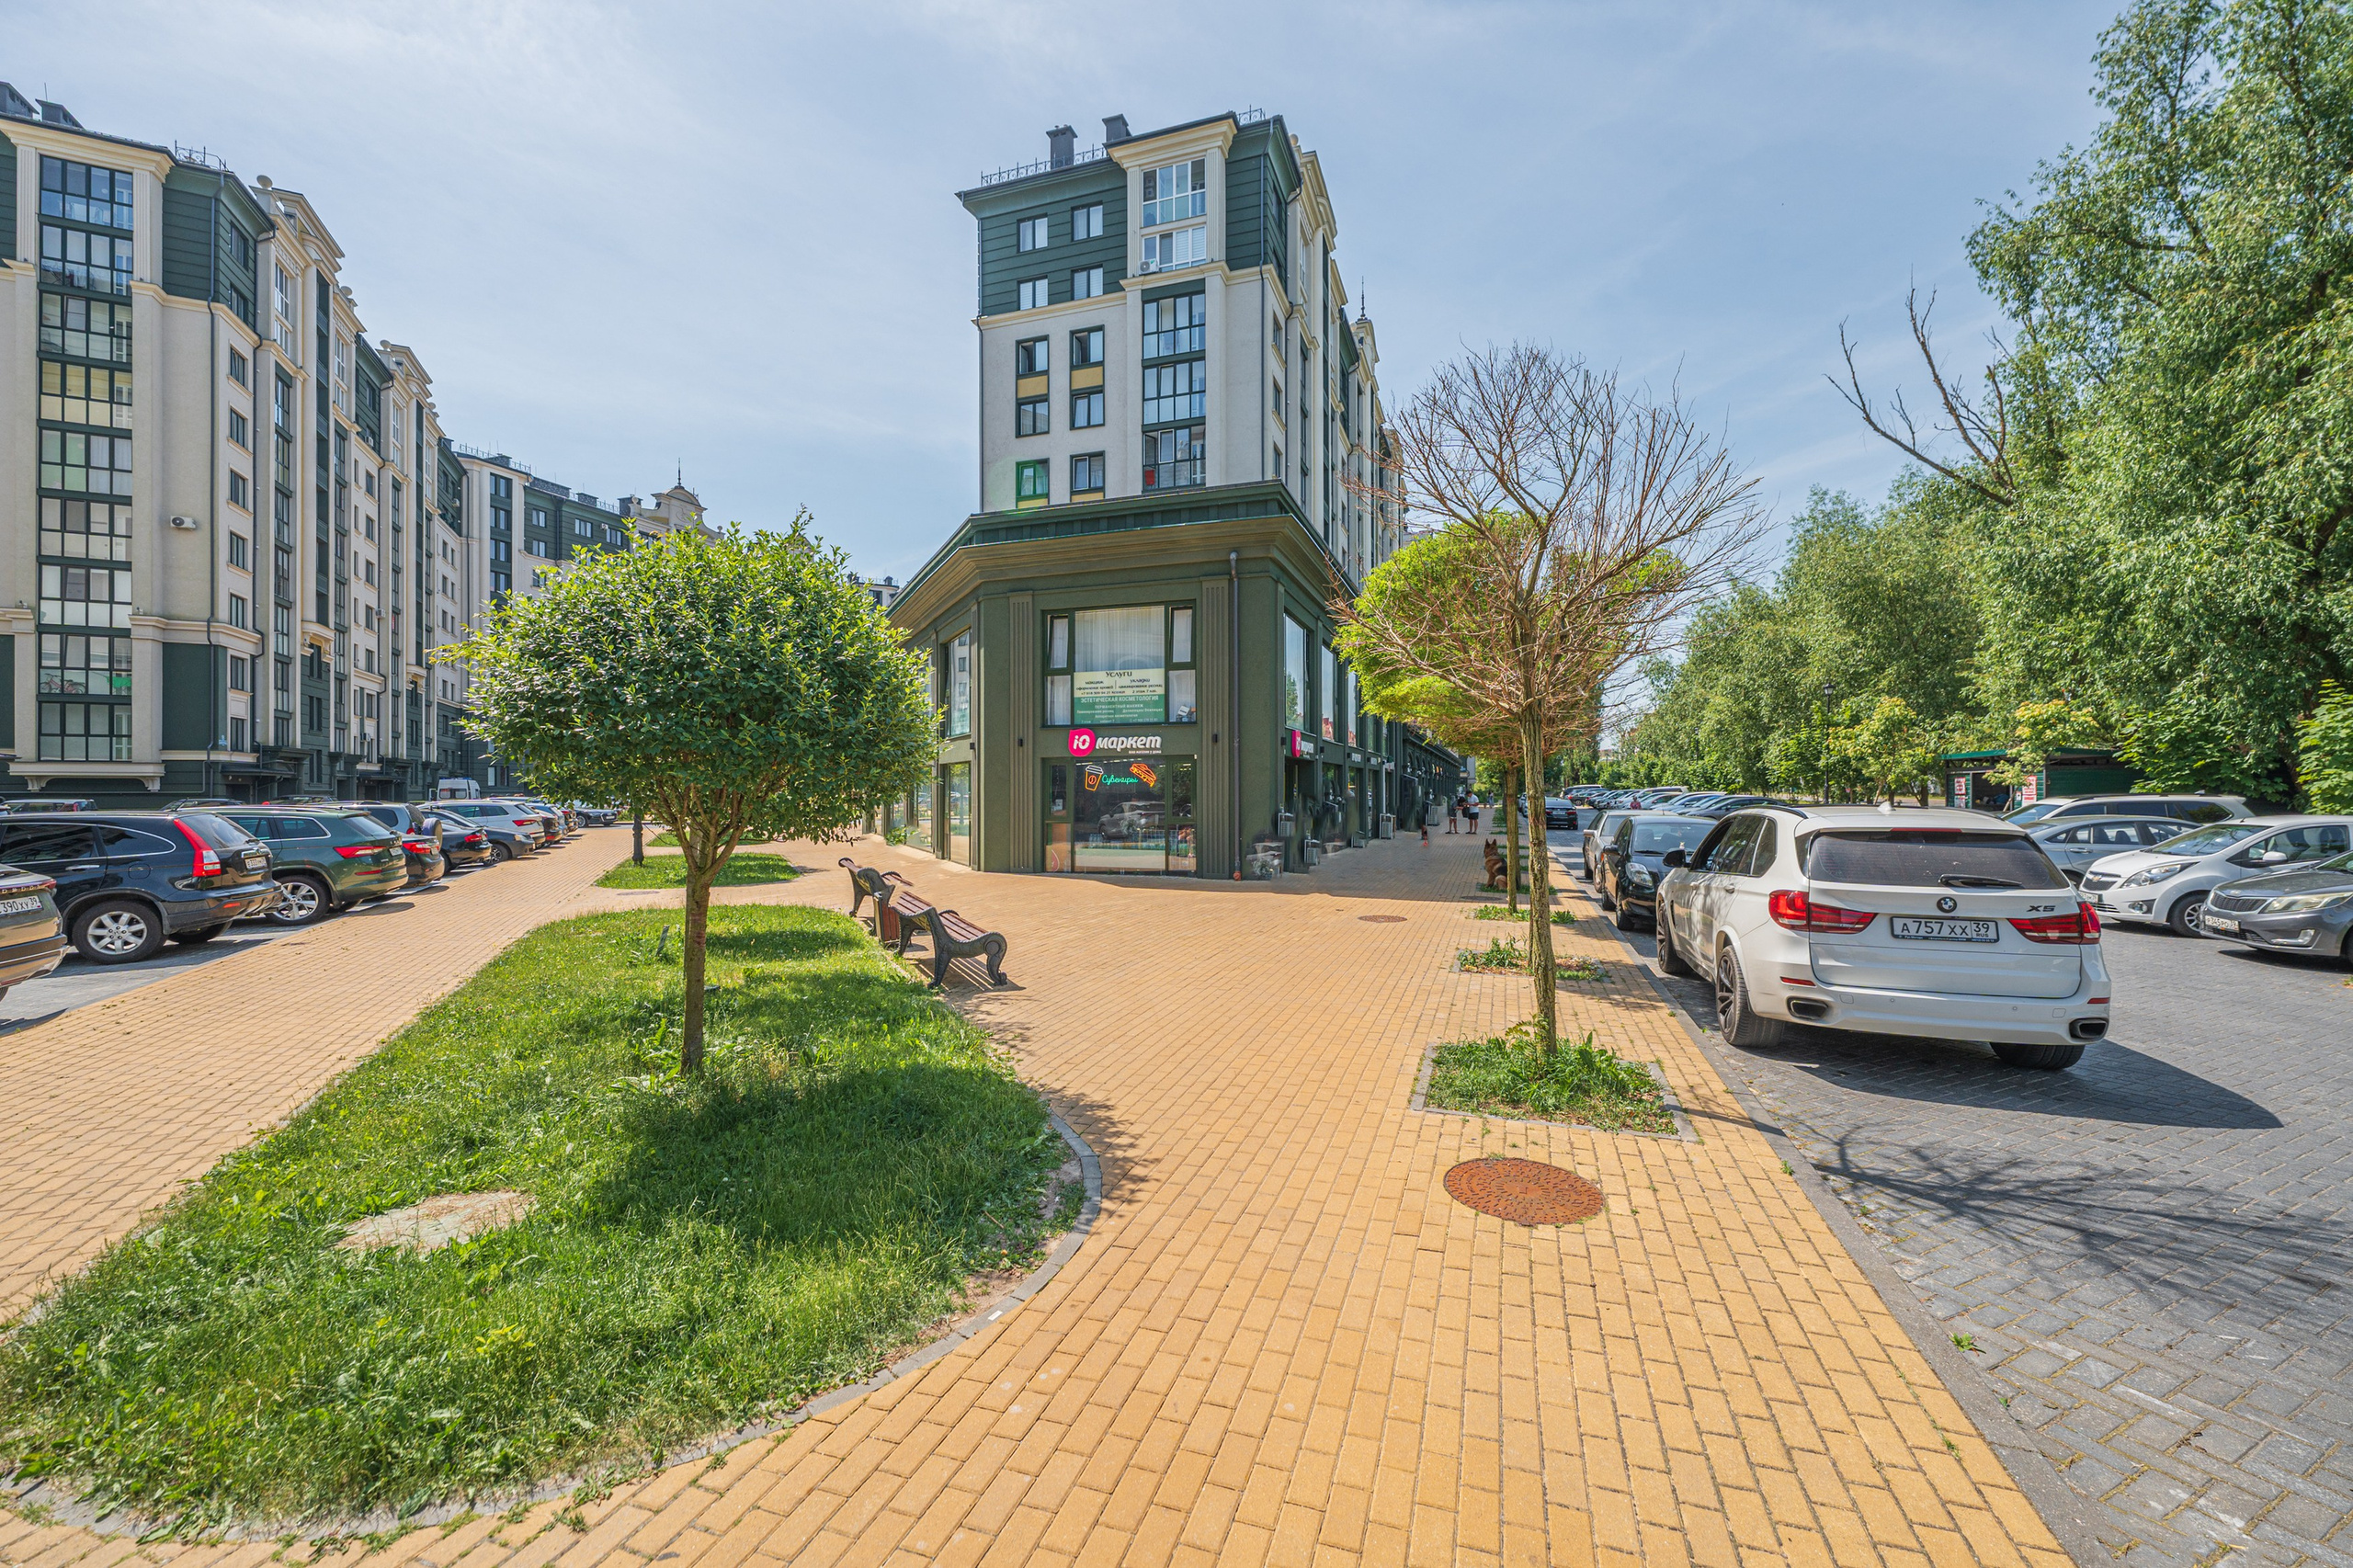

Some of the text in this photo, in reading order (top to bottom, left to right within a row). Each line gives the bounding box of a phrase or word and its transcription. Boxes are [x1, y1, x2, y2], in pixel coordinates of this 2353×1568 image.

[1095, 736, 1162, 752] маркет
[1101, 774, 1139, 786] Сувениры
[1973, 922, 1990, 933] 39
